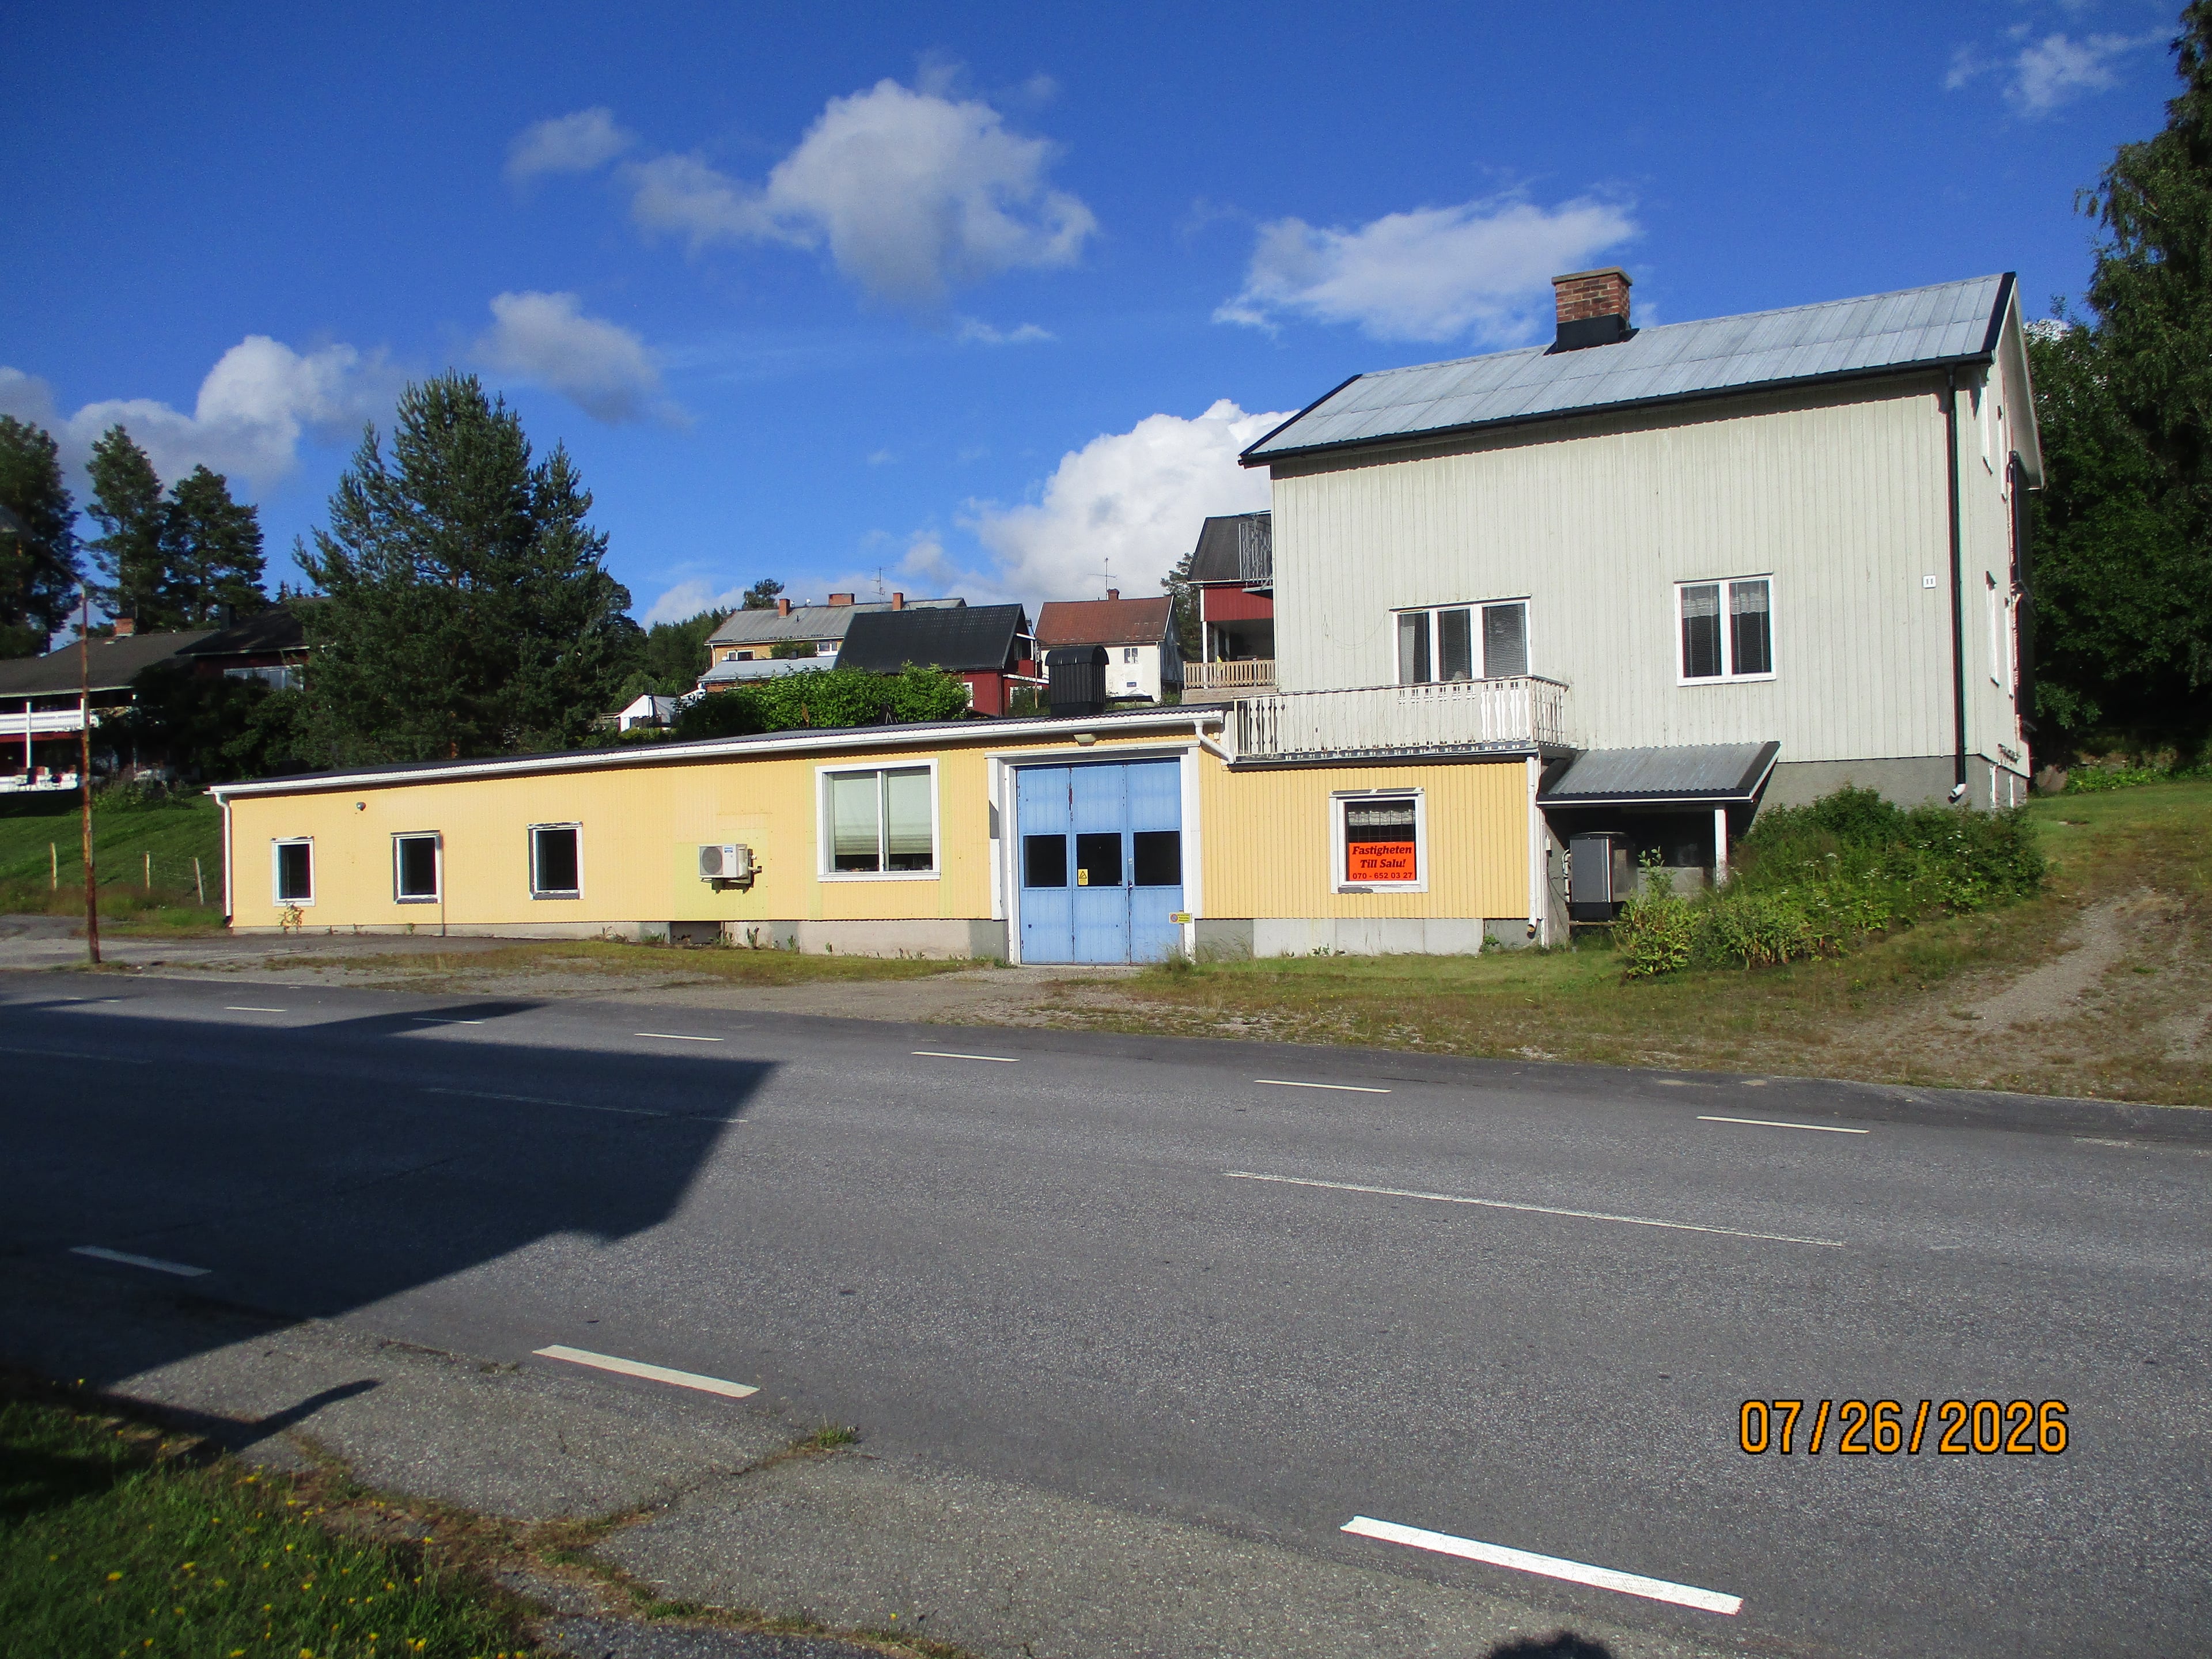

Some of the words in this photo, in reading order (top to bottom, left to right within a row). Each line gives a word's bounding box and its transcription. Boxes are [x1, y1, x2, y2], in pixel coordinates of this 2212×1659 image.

[1352, 845, 1412, 856] Fastigheten
[1360, 859, 1377, 868] Till
[1380, 859, 1406, 868] Salu!
